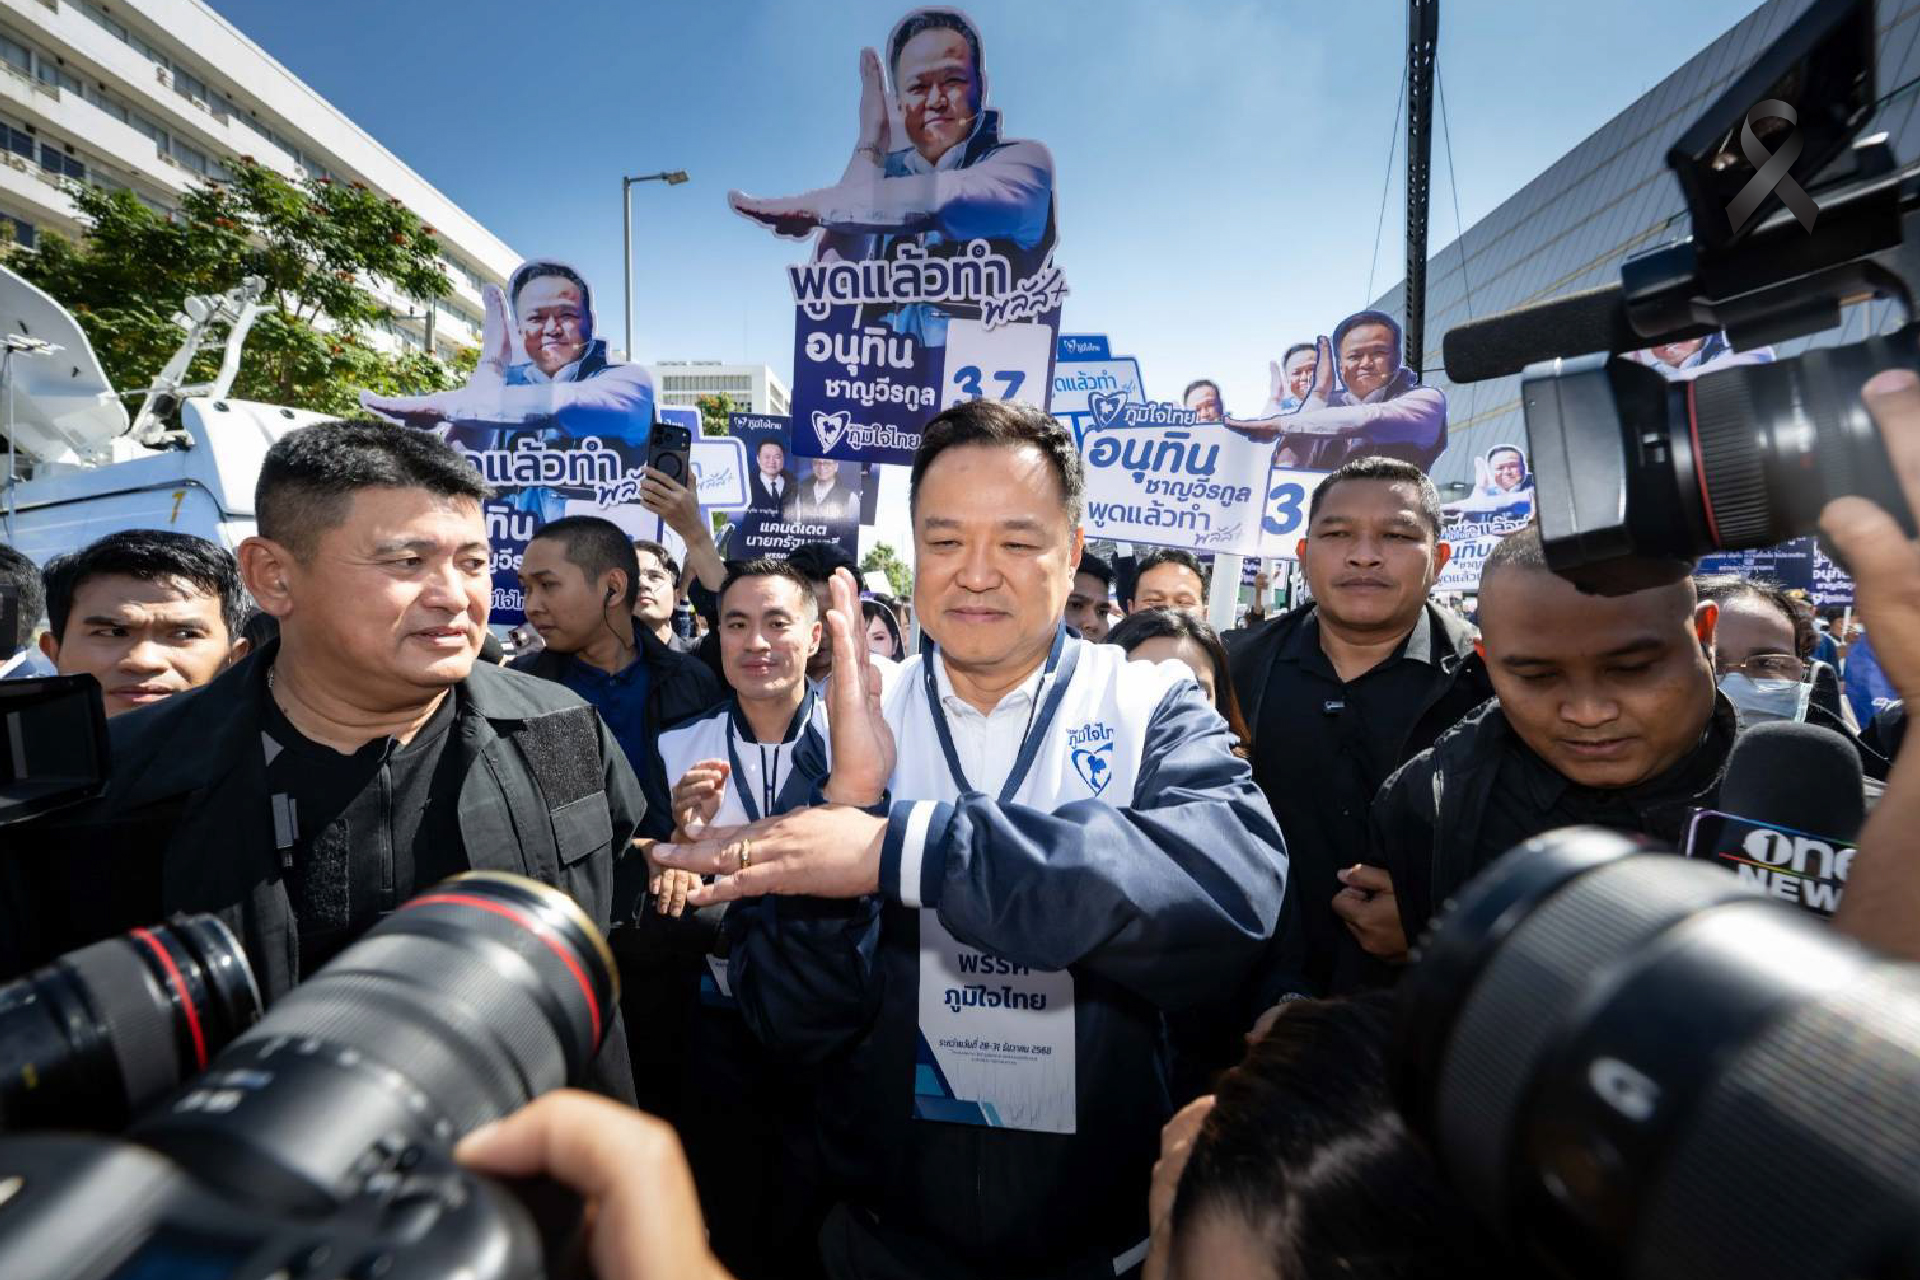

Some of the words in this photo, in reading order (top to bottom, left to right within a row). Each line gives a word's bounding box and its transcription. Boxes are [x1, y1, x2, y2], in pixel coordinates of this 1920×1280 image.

[789, 244, 1007, 317] พูดแล้วทำ
[805, 327, 915, 376] อนุทิน
[825, 379, 935, 412] ชาญวีรกูล
[953, 365, 1026, 406] 37
[1053, 369, 1118, 395] ดแล้วทำ
[1124, 402, 1198, 426] ภูมิใจไทย
[846, 424, 921, 450] ภูมิใจไทย
[1088, 432, 1220, 484] อนุทิน
[1145, 477, 1252, 508] ชาญวีรกูล
[1261, 483, 1305, 535] 3
[1088, 501, 1211, 530] พูดแล้วทำ
[1738, 863, 1845, 912] NEW
[944, 984, 1047, 1013] ภูมิใจไทย
